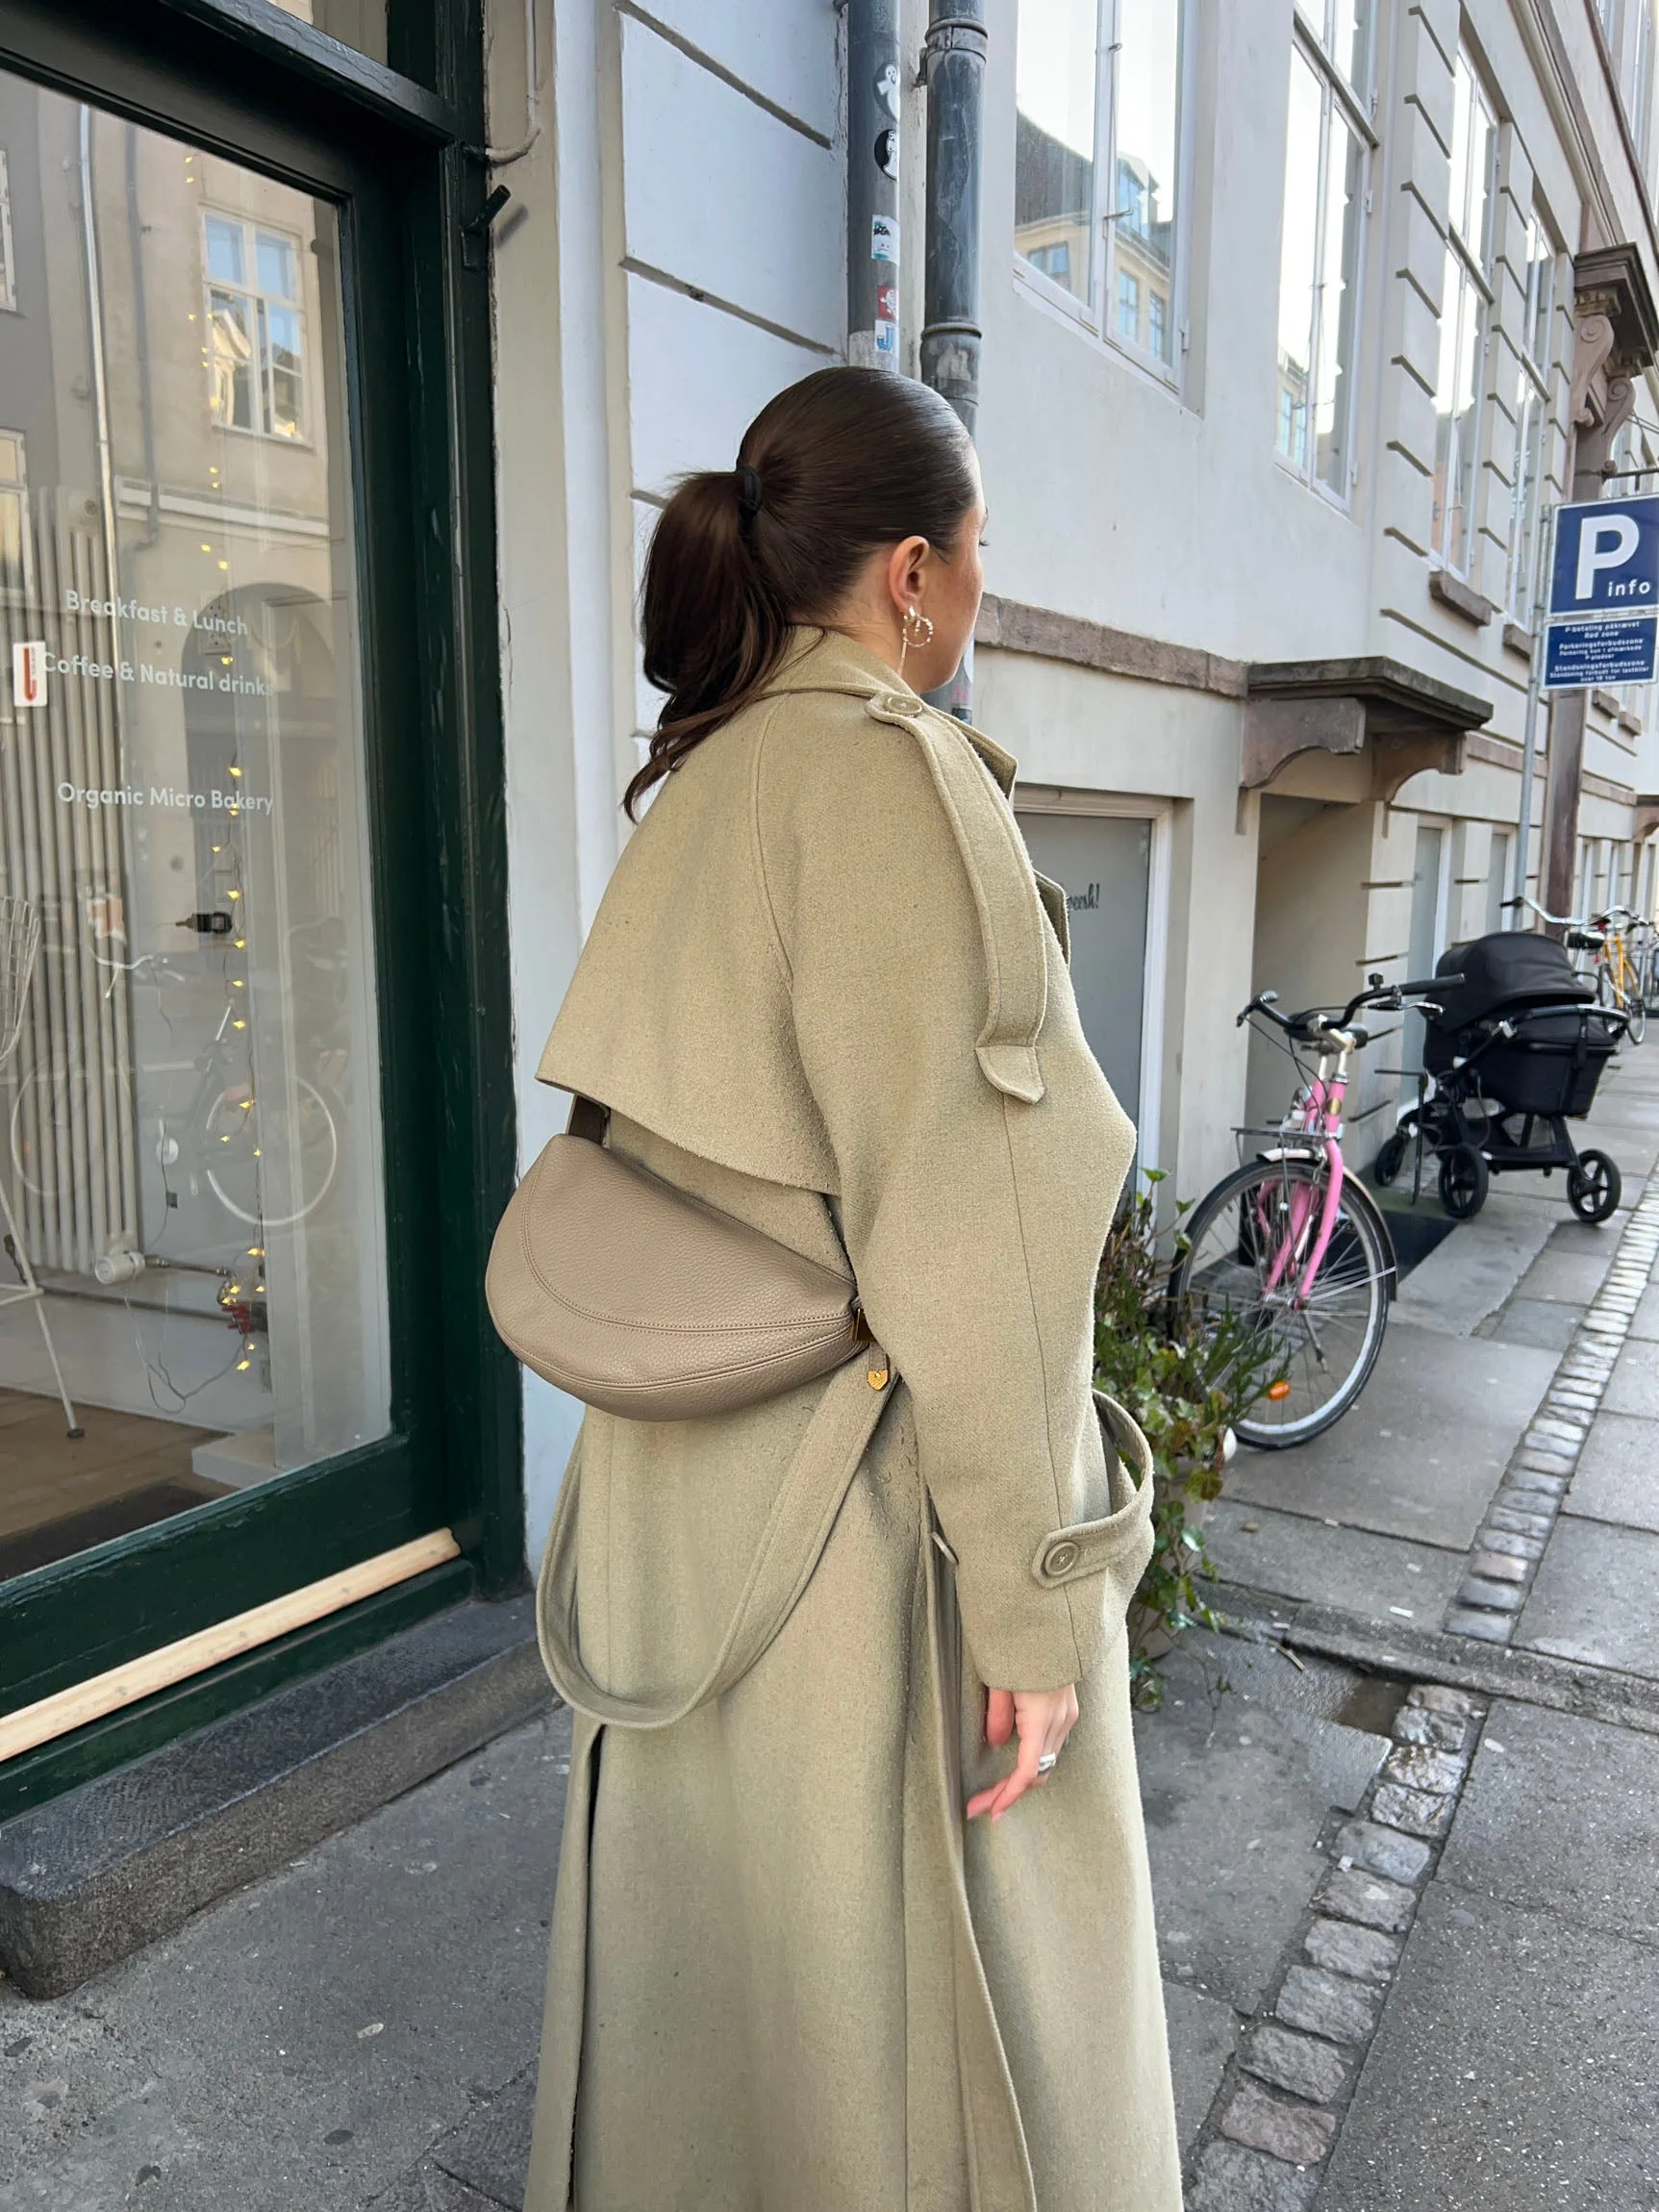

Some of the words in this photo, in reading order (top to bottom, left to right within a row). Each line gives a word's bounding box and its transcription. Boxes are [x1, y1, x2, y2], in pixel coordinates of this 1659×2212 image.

[1574, 514, 1640, 600] P
[1608, 579, 1651, 597] info
[65, 590, 168, 623] Breakfast
[173, 607, 188, 626] &
[193, 611, 248, 635] Lunch
[43, 651, 113, 679] Coffee
[120, 664, 135, 682] &
[140, 664, 214, 691] Natural
[218, 673, 275, 696] drinks
[57, 781, 144, 809] Organic
[150, 787, 205, 809] Micro
[212, 790, 273, 816] Bakery
